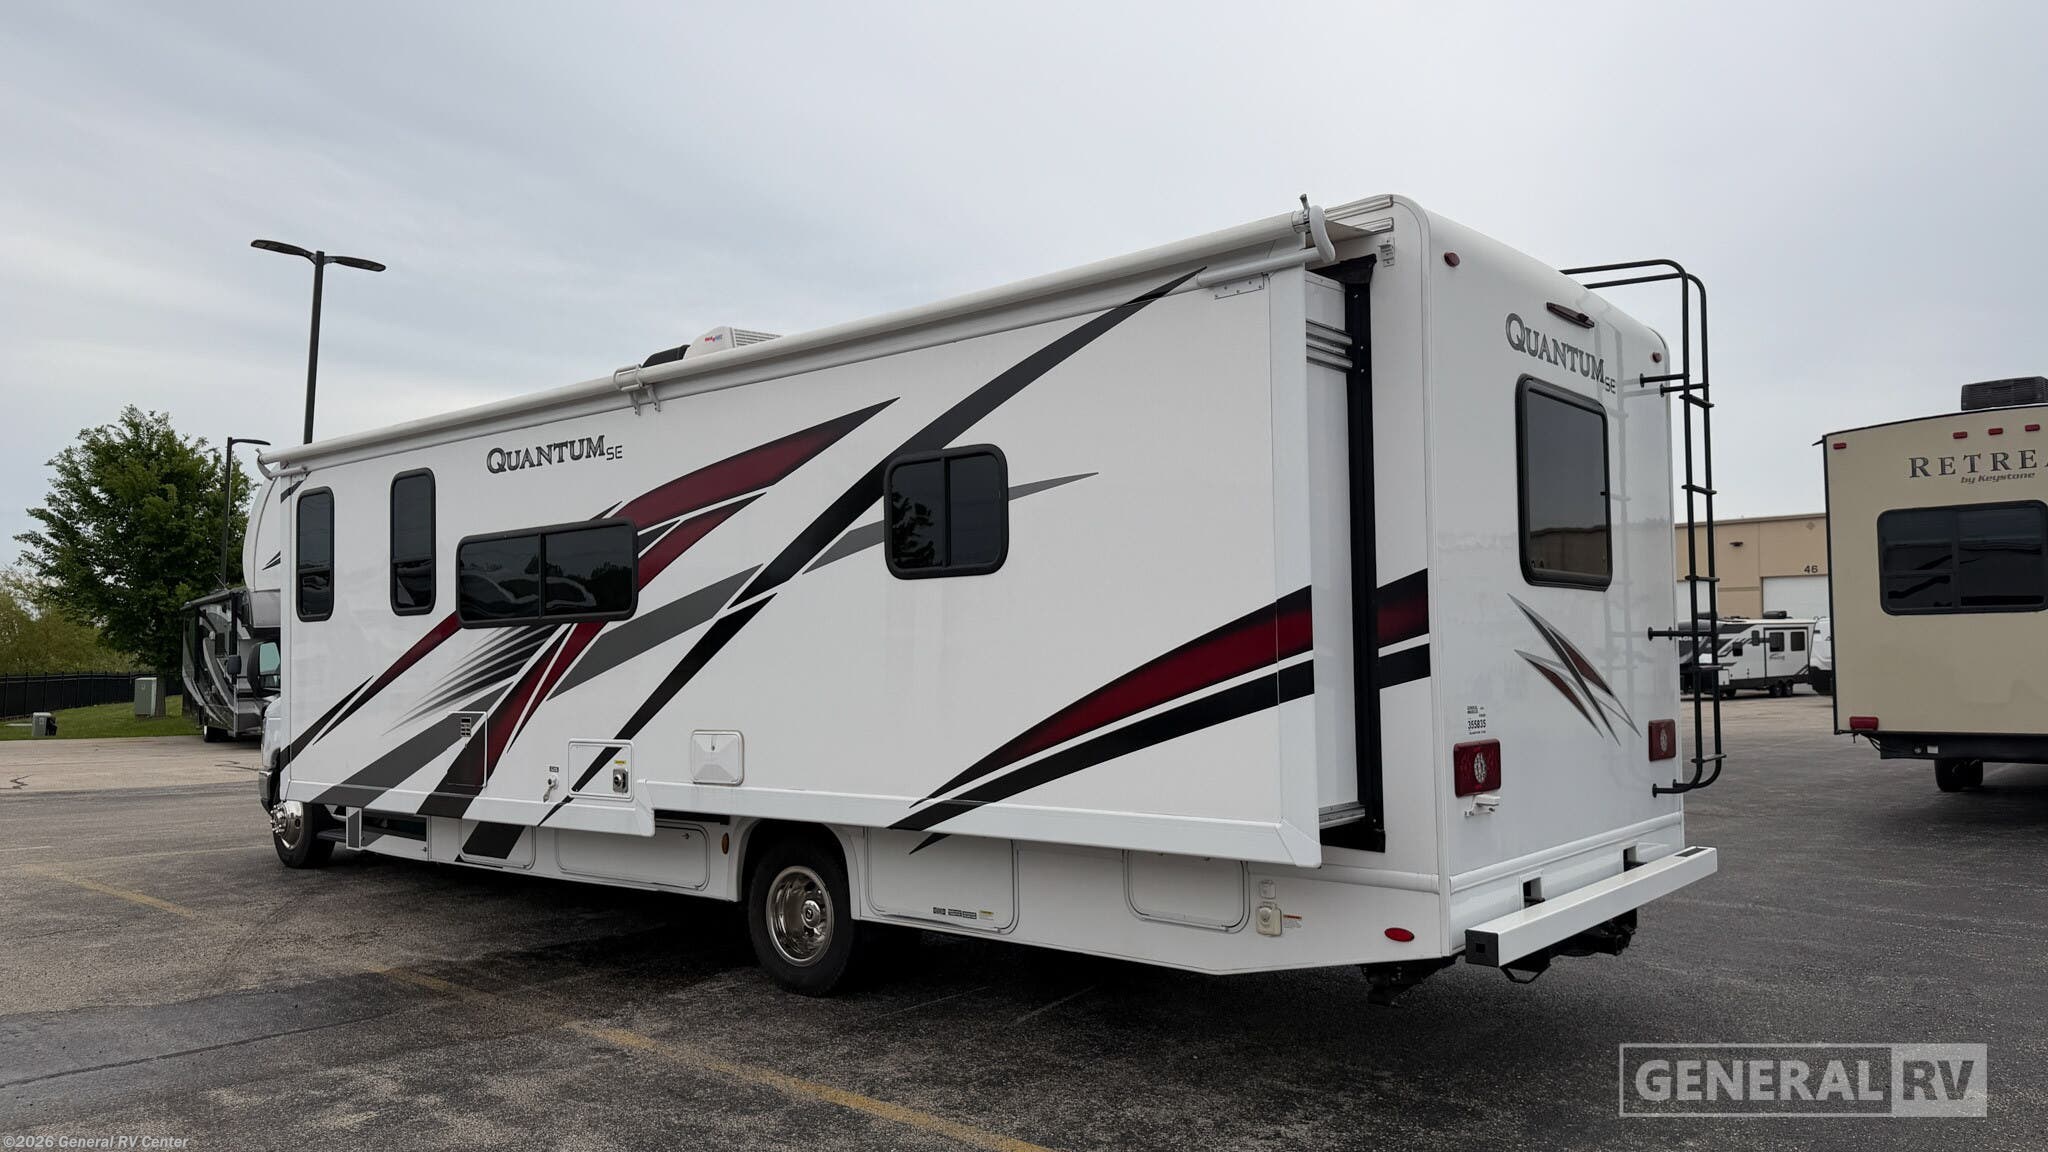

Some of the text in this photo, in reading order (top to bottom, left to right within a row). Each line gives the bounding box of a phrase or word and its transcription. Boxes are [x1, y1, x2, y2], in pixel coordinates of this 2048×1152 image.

[1505, 312, 1617, 395] QUANTUM SE
[486, 434, 623, 474] QUANTUM SE
[1908, 448, 2048, 479] RETRE
[1960, 472, 2036, 485] by Keystone
